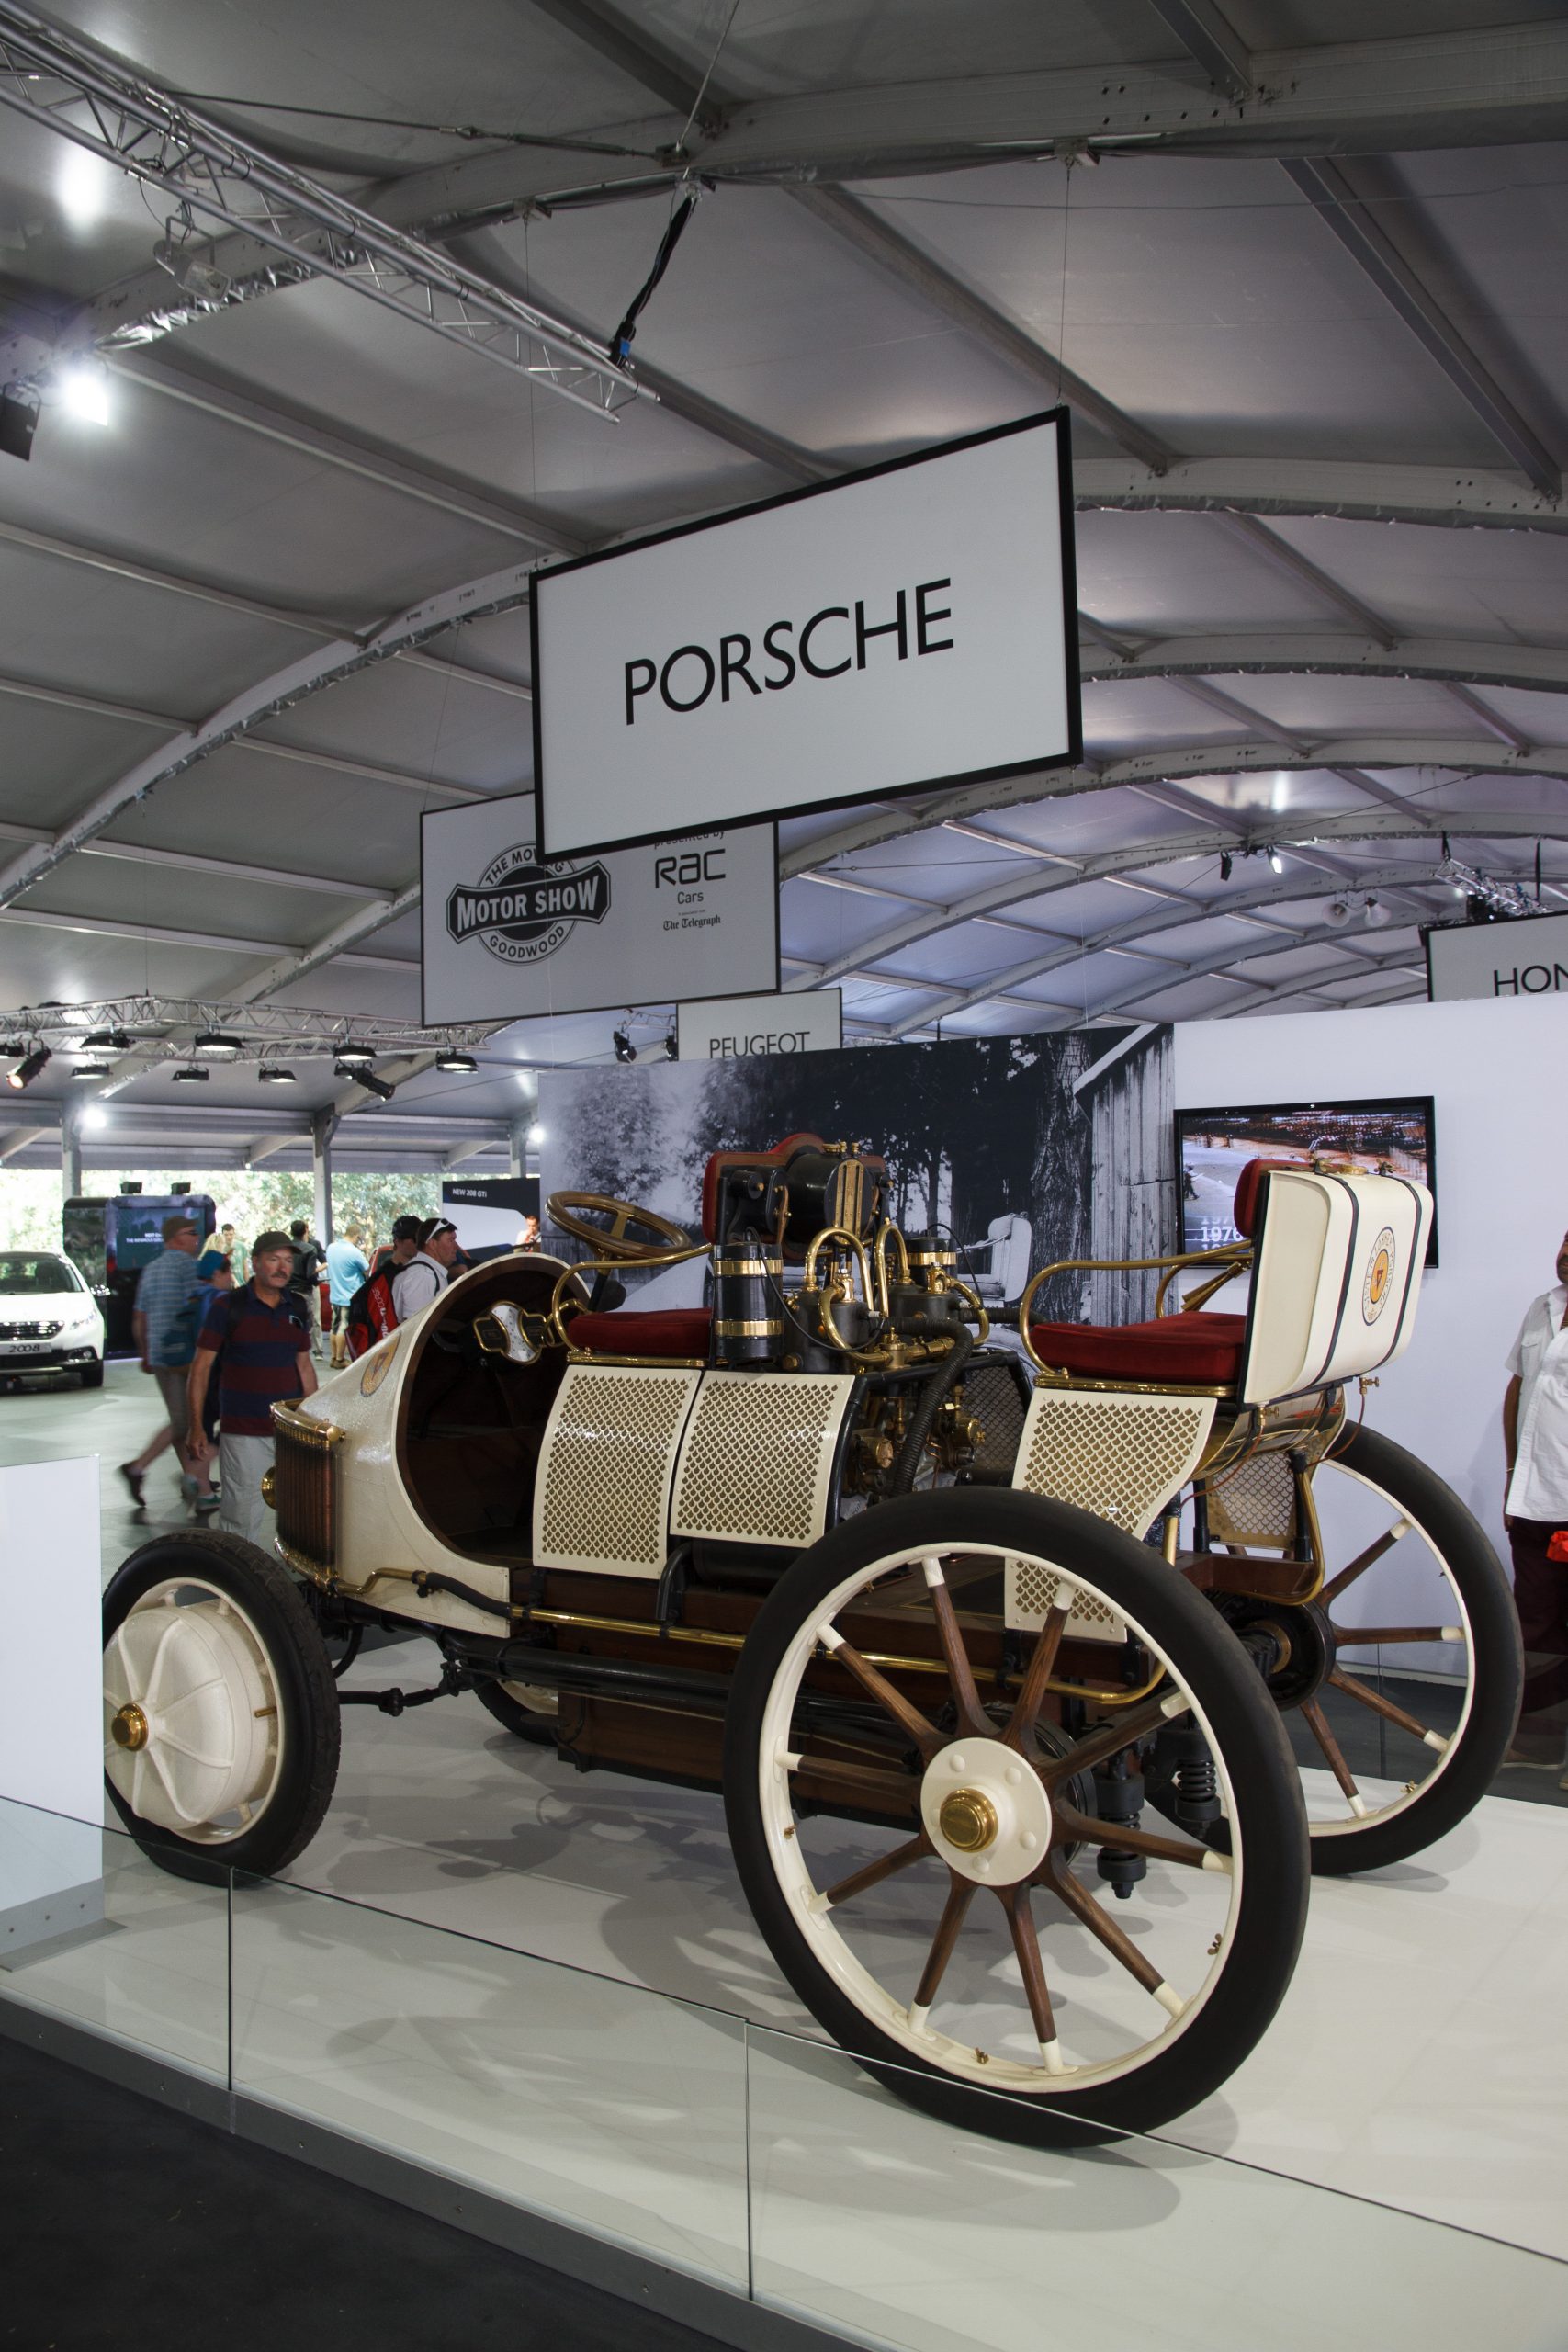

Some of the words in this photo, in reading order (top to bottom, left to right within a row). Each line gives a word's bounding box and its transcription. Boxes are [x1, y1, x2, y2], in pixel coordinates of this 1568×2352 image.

[625, 577, 954, 726] PORSCHE
[485, 858, 509, 886] THE
[457, 893, 528, 933] MOTOR
[535, 875, 599, 915] SHOW
[677, 891, 704, 905] Cars
[663, 920, 679, 931] The
[681, 914, 721, 929] Telegraph
[490, 926, 565, 958] GOODWOOD
[710, 1031, 810, 1059] PEUGEOT
[452, 1188, 466, 1196] NEW
[1201, 1226, 1244, 1242] 1976
[8, 1344, 40, 1353] 2008
